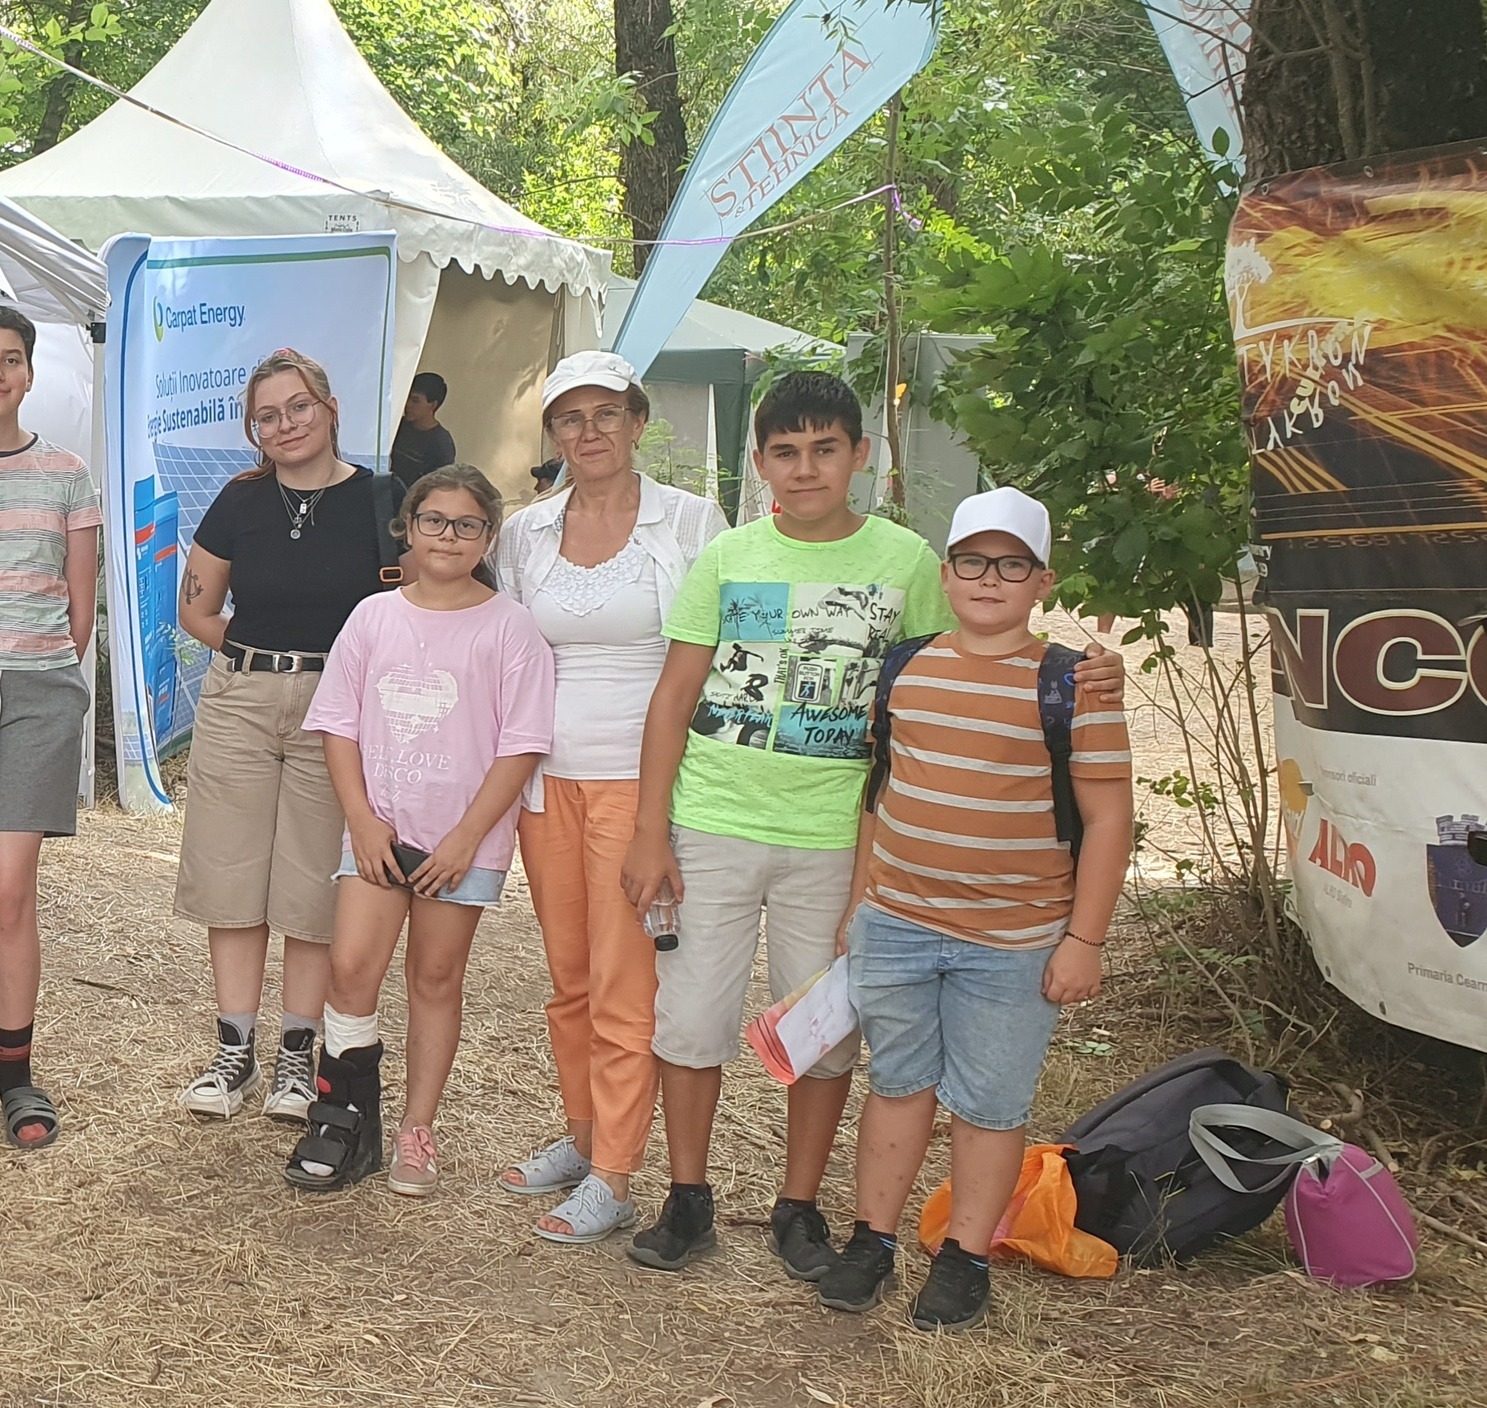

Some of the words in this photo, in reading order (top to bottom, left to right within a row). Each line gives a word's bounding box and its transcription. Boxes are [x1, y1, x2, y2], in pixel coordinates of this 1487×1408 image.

[742, 104, 851, 211] TEHNICA
[165, 306, 197, 333] Carpat
[199, 302, 245, 328] Energy
[179, 366, 247, 394] Inovatoare
[792, 606, 820, 620] OWN
[825, 605, 851, 619] WAY
[869, 602, 901, 626] STAY
[789, 701, 869, 728] AWESOME
[804, 725, 855, 746] TODAY
[396, 749, 451, 770] LOVE
